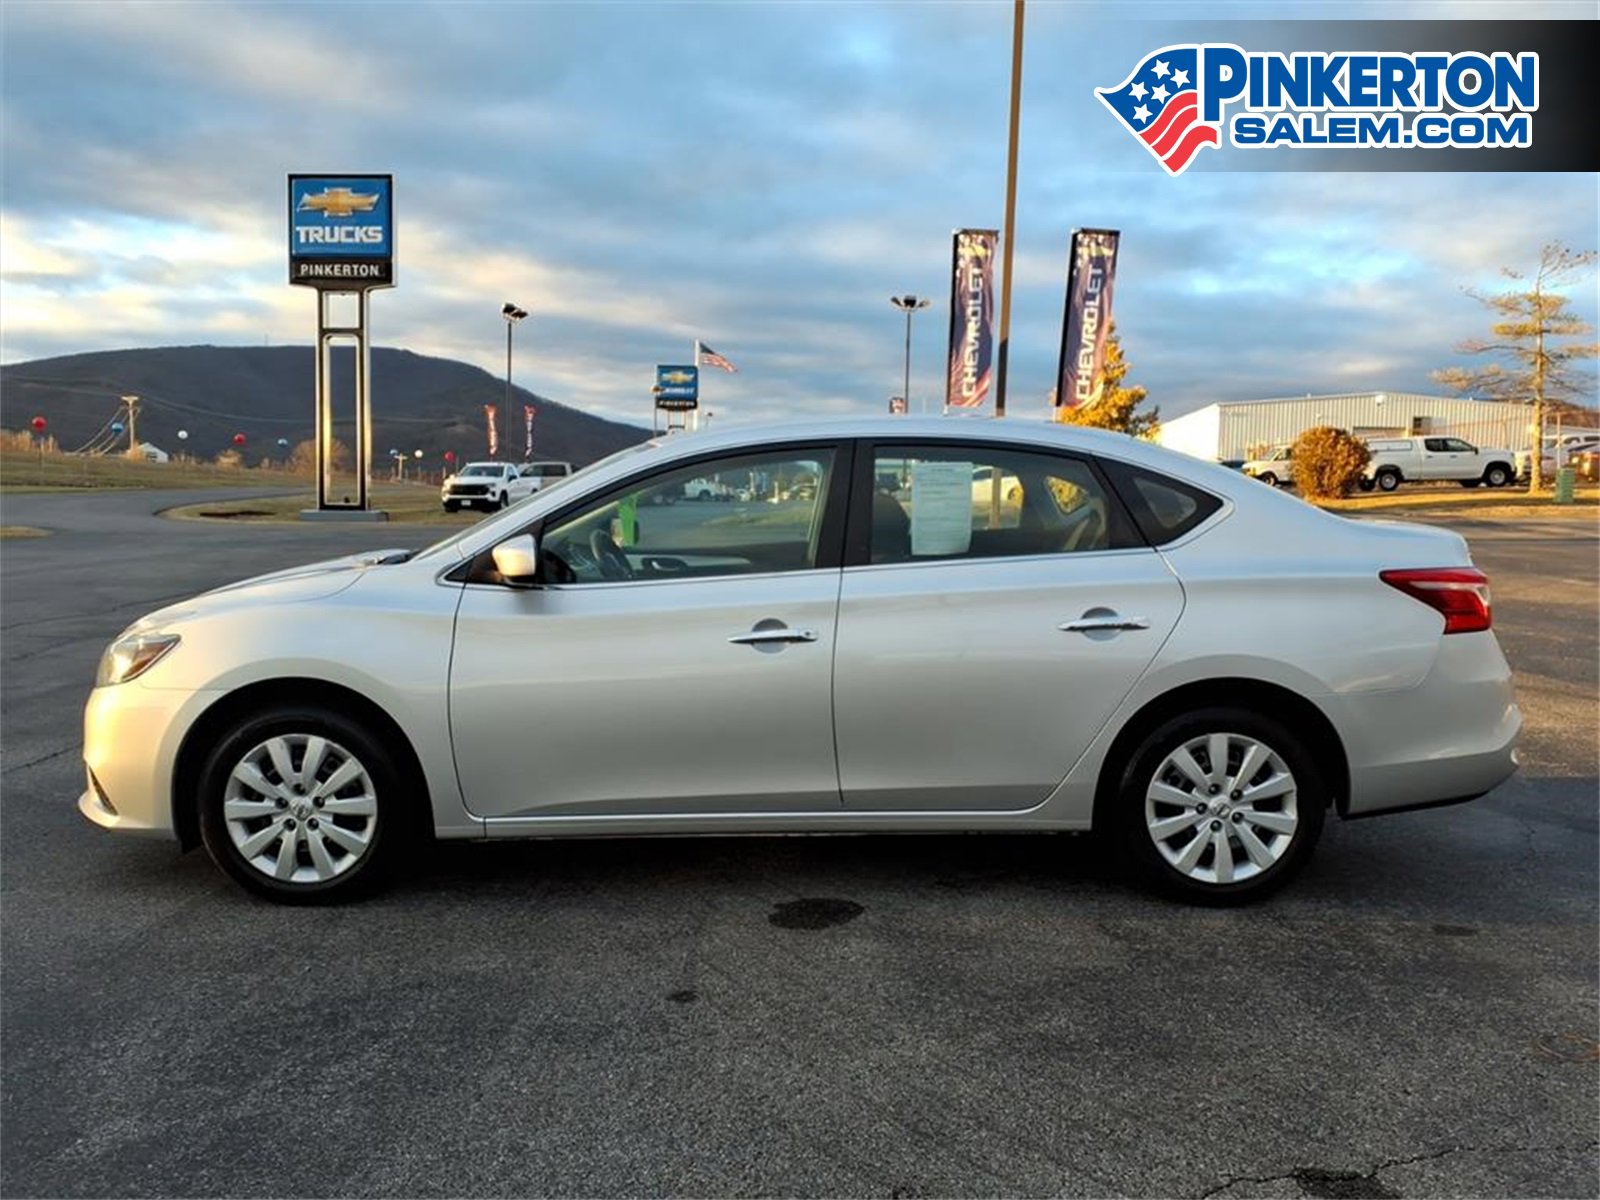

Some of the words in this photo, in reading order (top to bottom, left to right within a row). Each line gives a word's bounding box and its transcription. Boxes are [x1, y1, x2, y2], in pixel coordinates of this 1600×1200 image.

[296, 226, 383, 243] TRUCKS
[300, 264, 379, 276] PINKERTON
[962, 266, 983, 396] CHEVROLET
[1075, 264, 1102, 400] CHEVROLET
